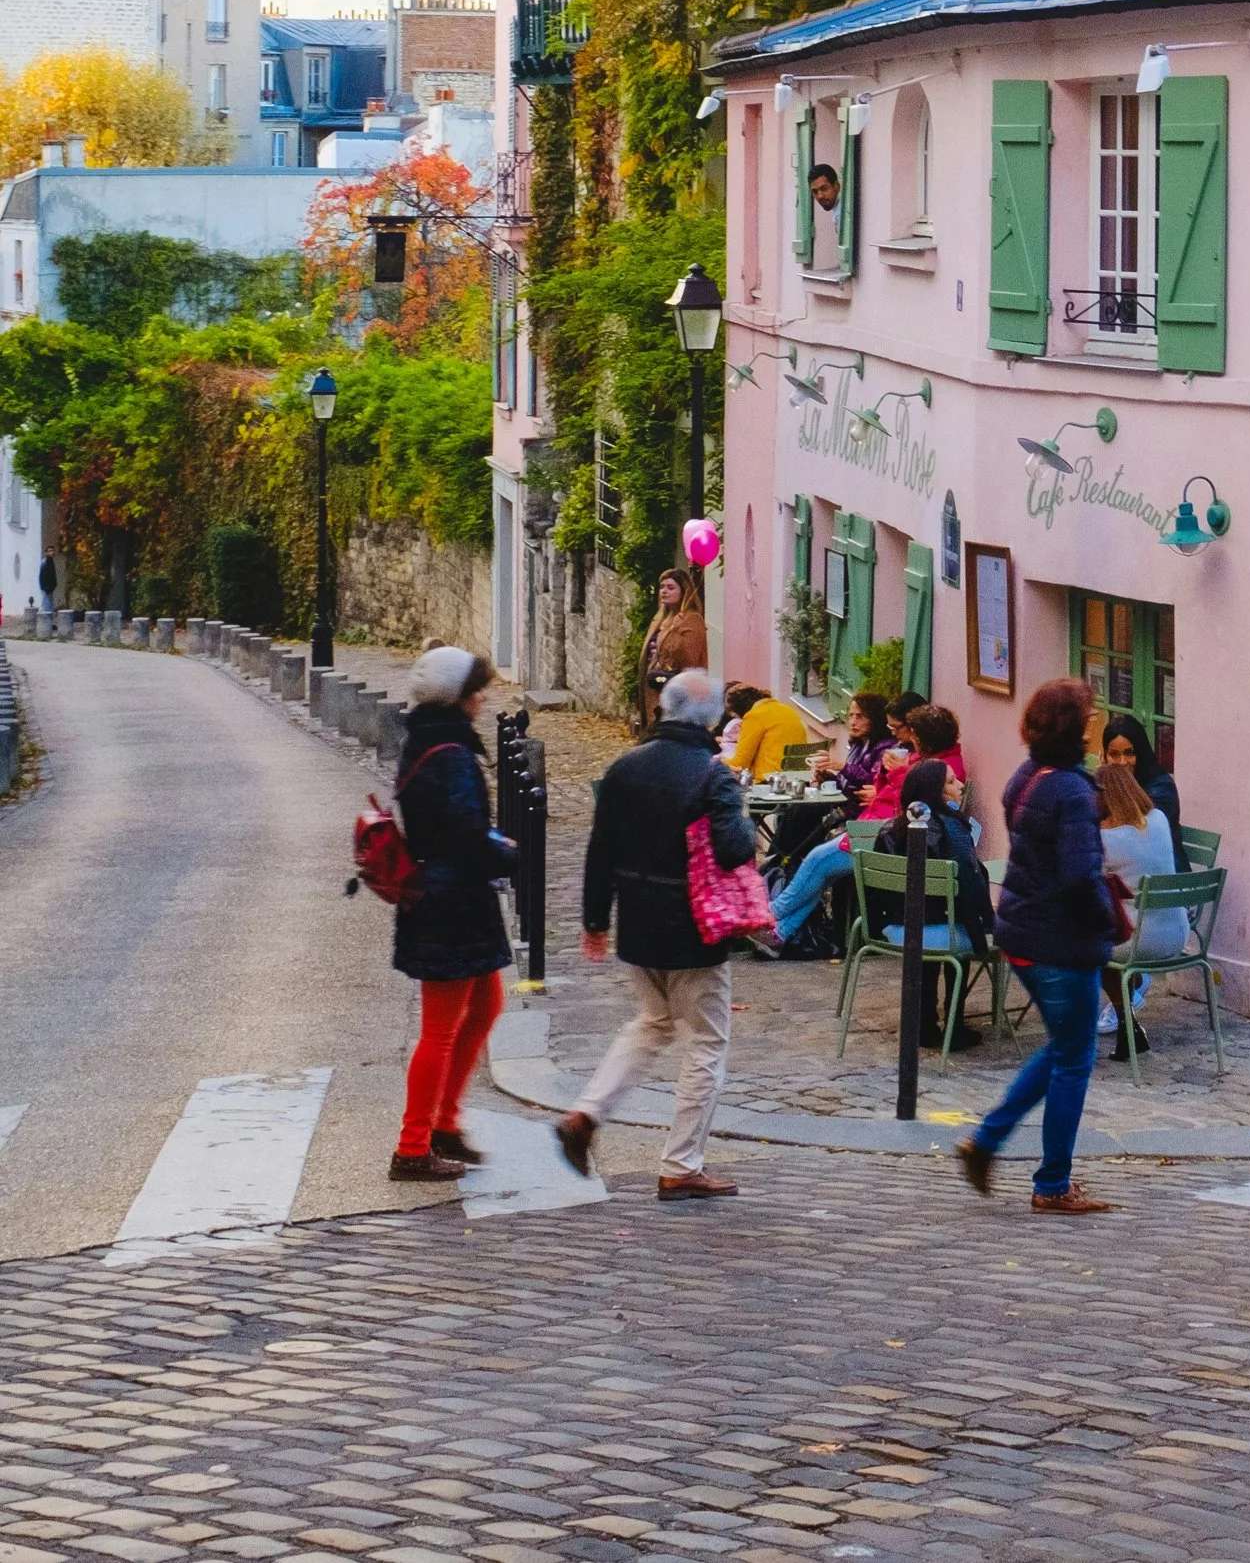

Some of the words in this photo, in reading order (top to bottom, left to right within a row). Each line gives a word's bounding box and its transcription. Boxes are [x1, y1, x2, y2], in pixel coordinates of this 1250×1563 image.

[891, 396, 936, 500] Rose
[1026, 468, 1065, 531] Café
[1069, 455, 1178, 538] Restaurant
